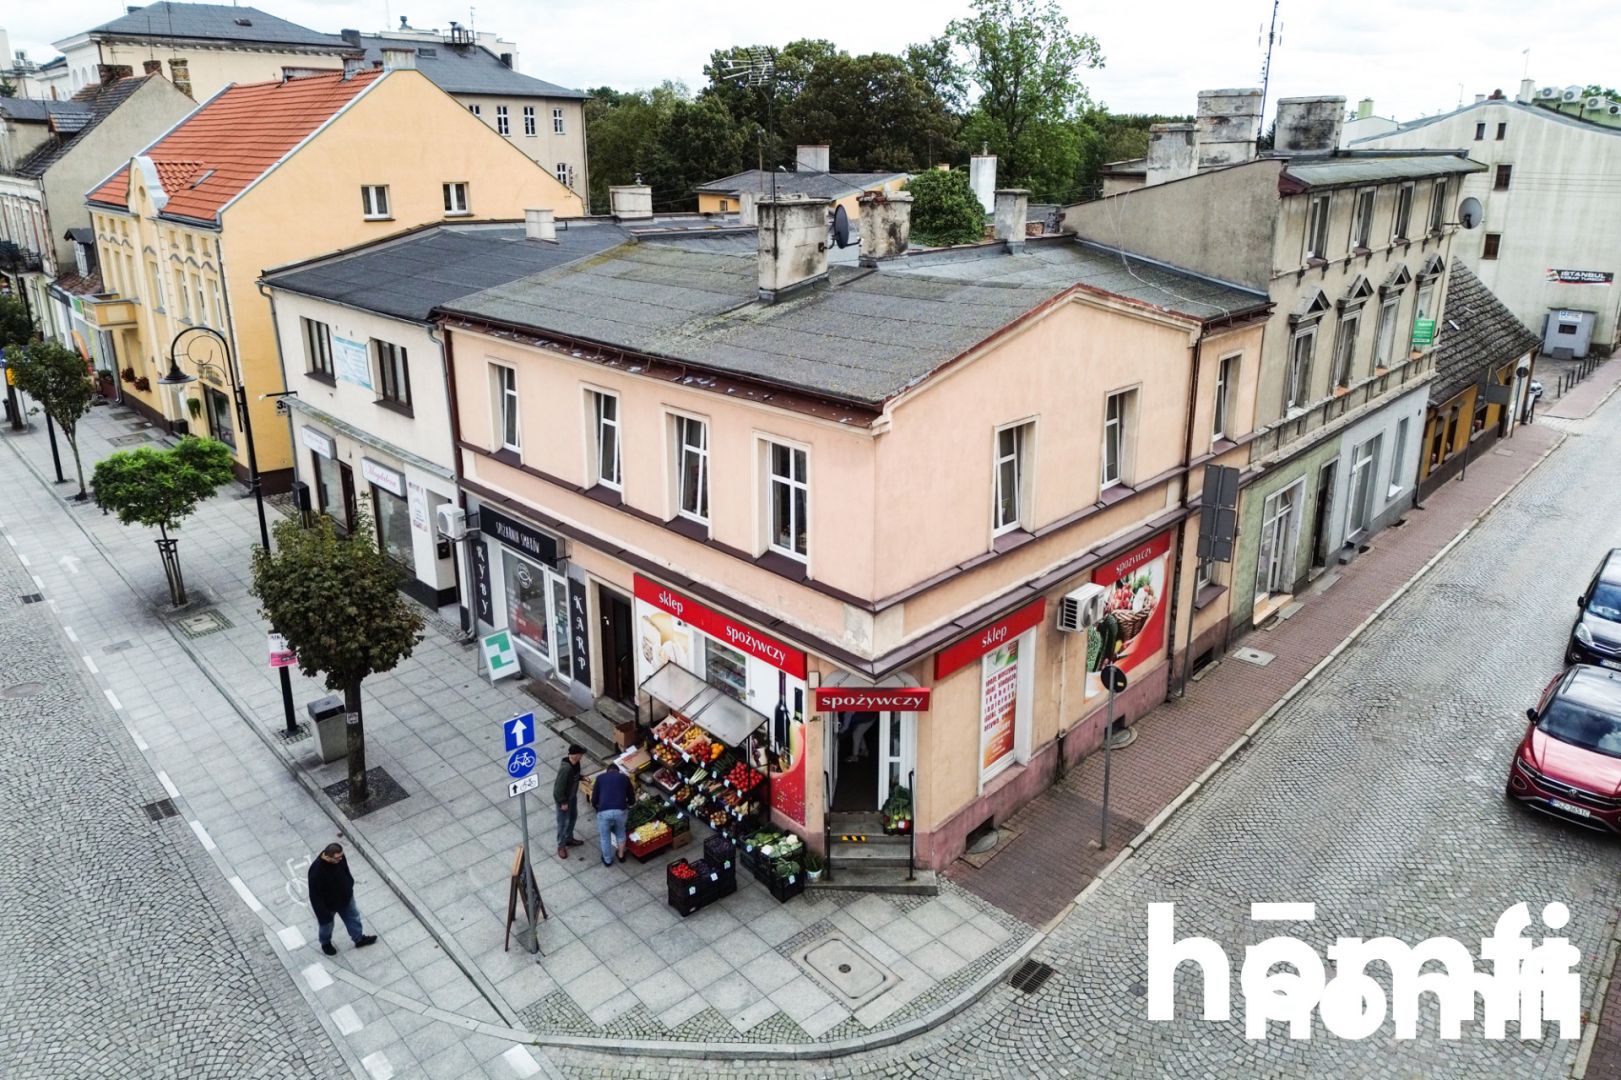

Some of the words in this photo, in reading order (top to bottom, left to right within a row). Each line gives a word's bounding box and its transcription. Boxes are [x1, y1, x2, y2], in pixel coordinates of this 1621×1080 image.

[1561, 271, 1606, 279] ISTANBUL
[476, 545, 489, 615] RYBY
[573, 595, 586, 671] KARP
[658, 590, 684, 615] sklep
[726, 624, 786, 666] spożywczy
[981, 625, 1008, 648] sklep
[821, 692, 924, 708] spożywczy
